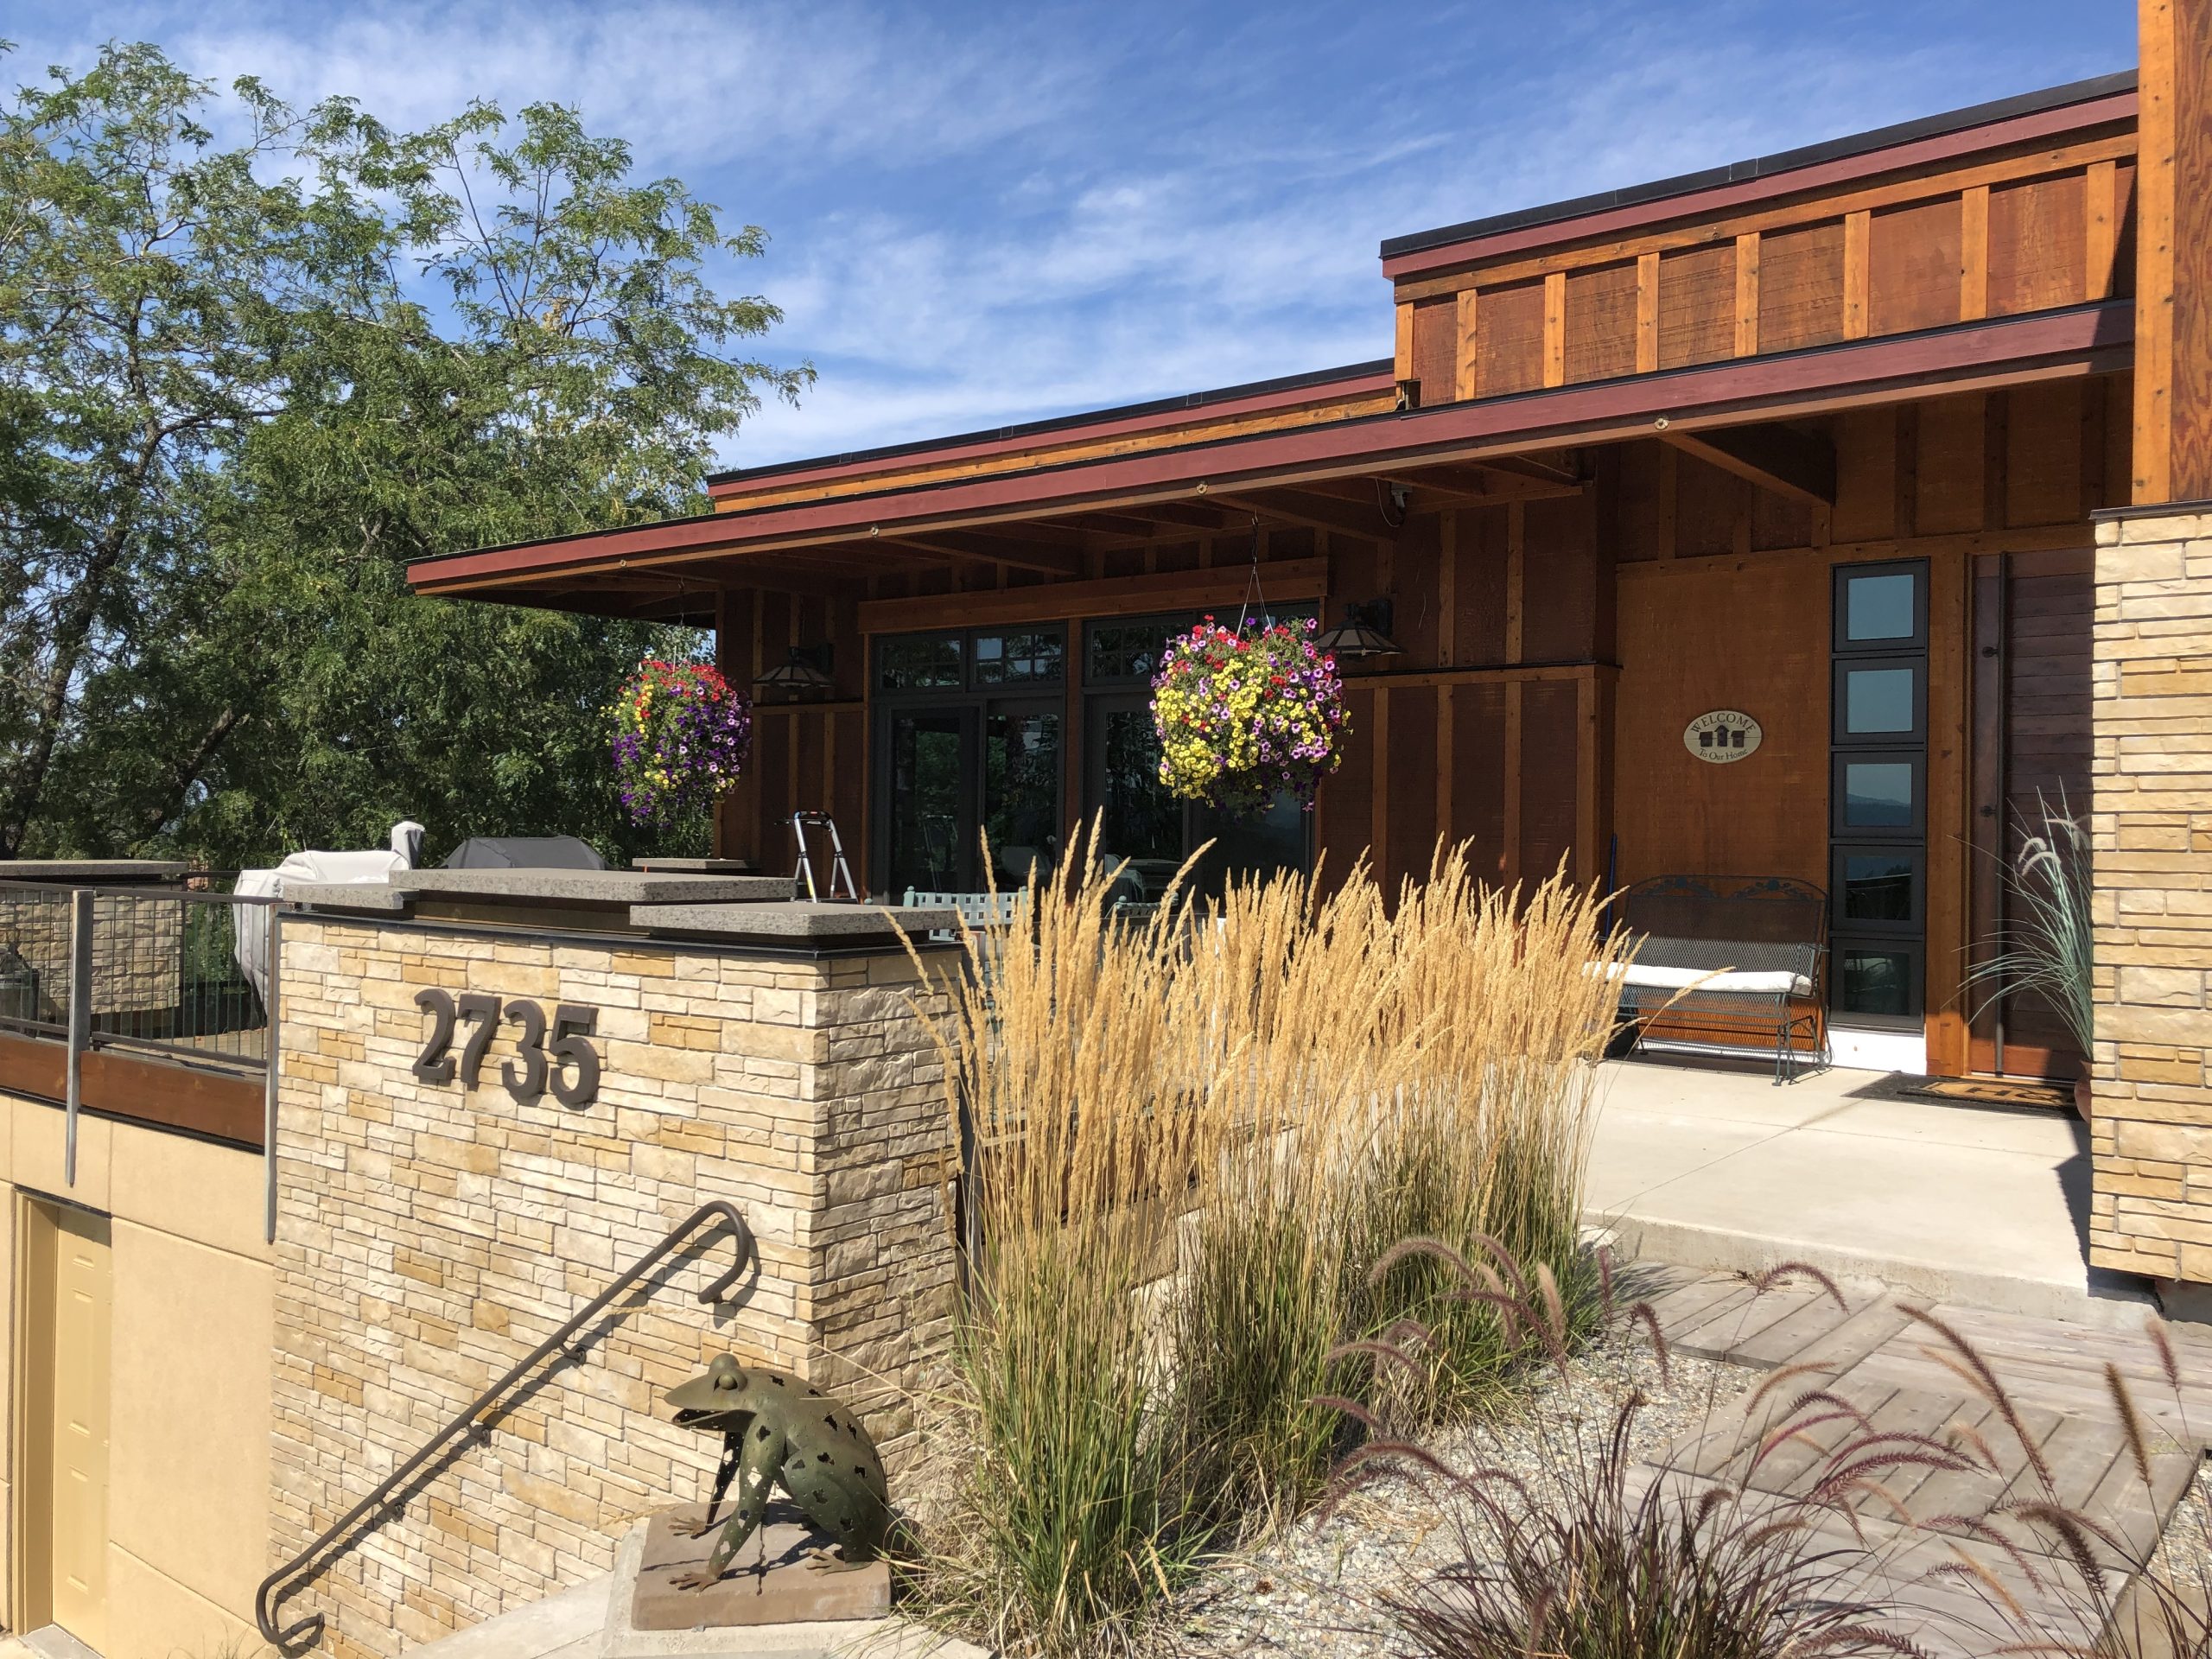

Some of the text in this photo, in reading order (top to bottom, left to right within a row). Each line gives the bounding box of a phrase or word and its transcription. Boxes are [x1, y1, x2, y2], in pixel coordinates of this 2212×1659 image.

[1690, 713, 1756, 734] WELCOME
[1699, 748, 1748, 760] To Our Home
[412, 988, 601, 1106] 2735
